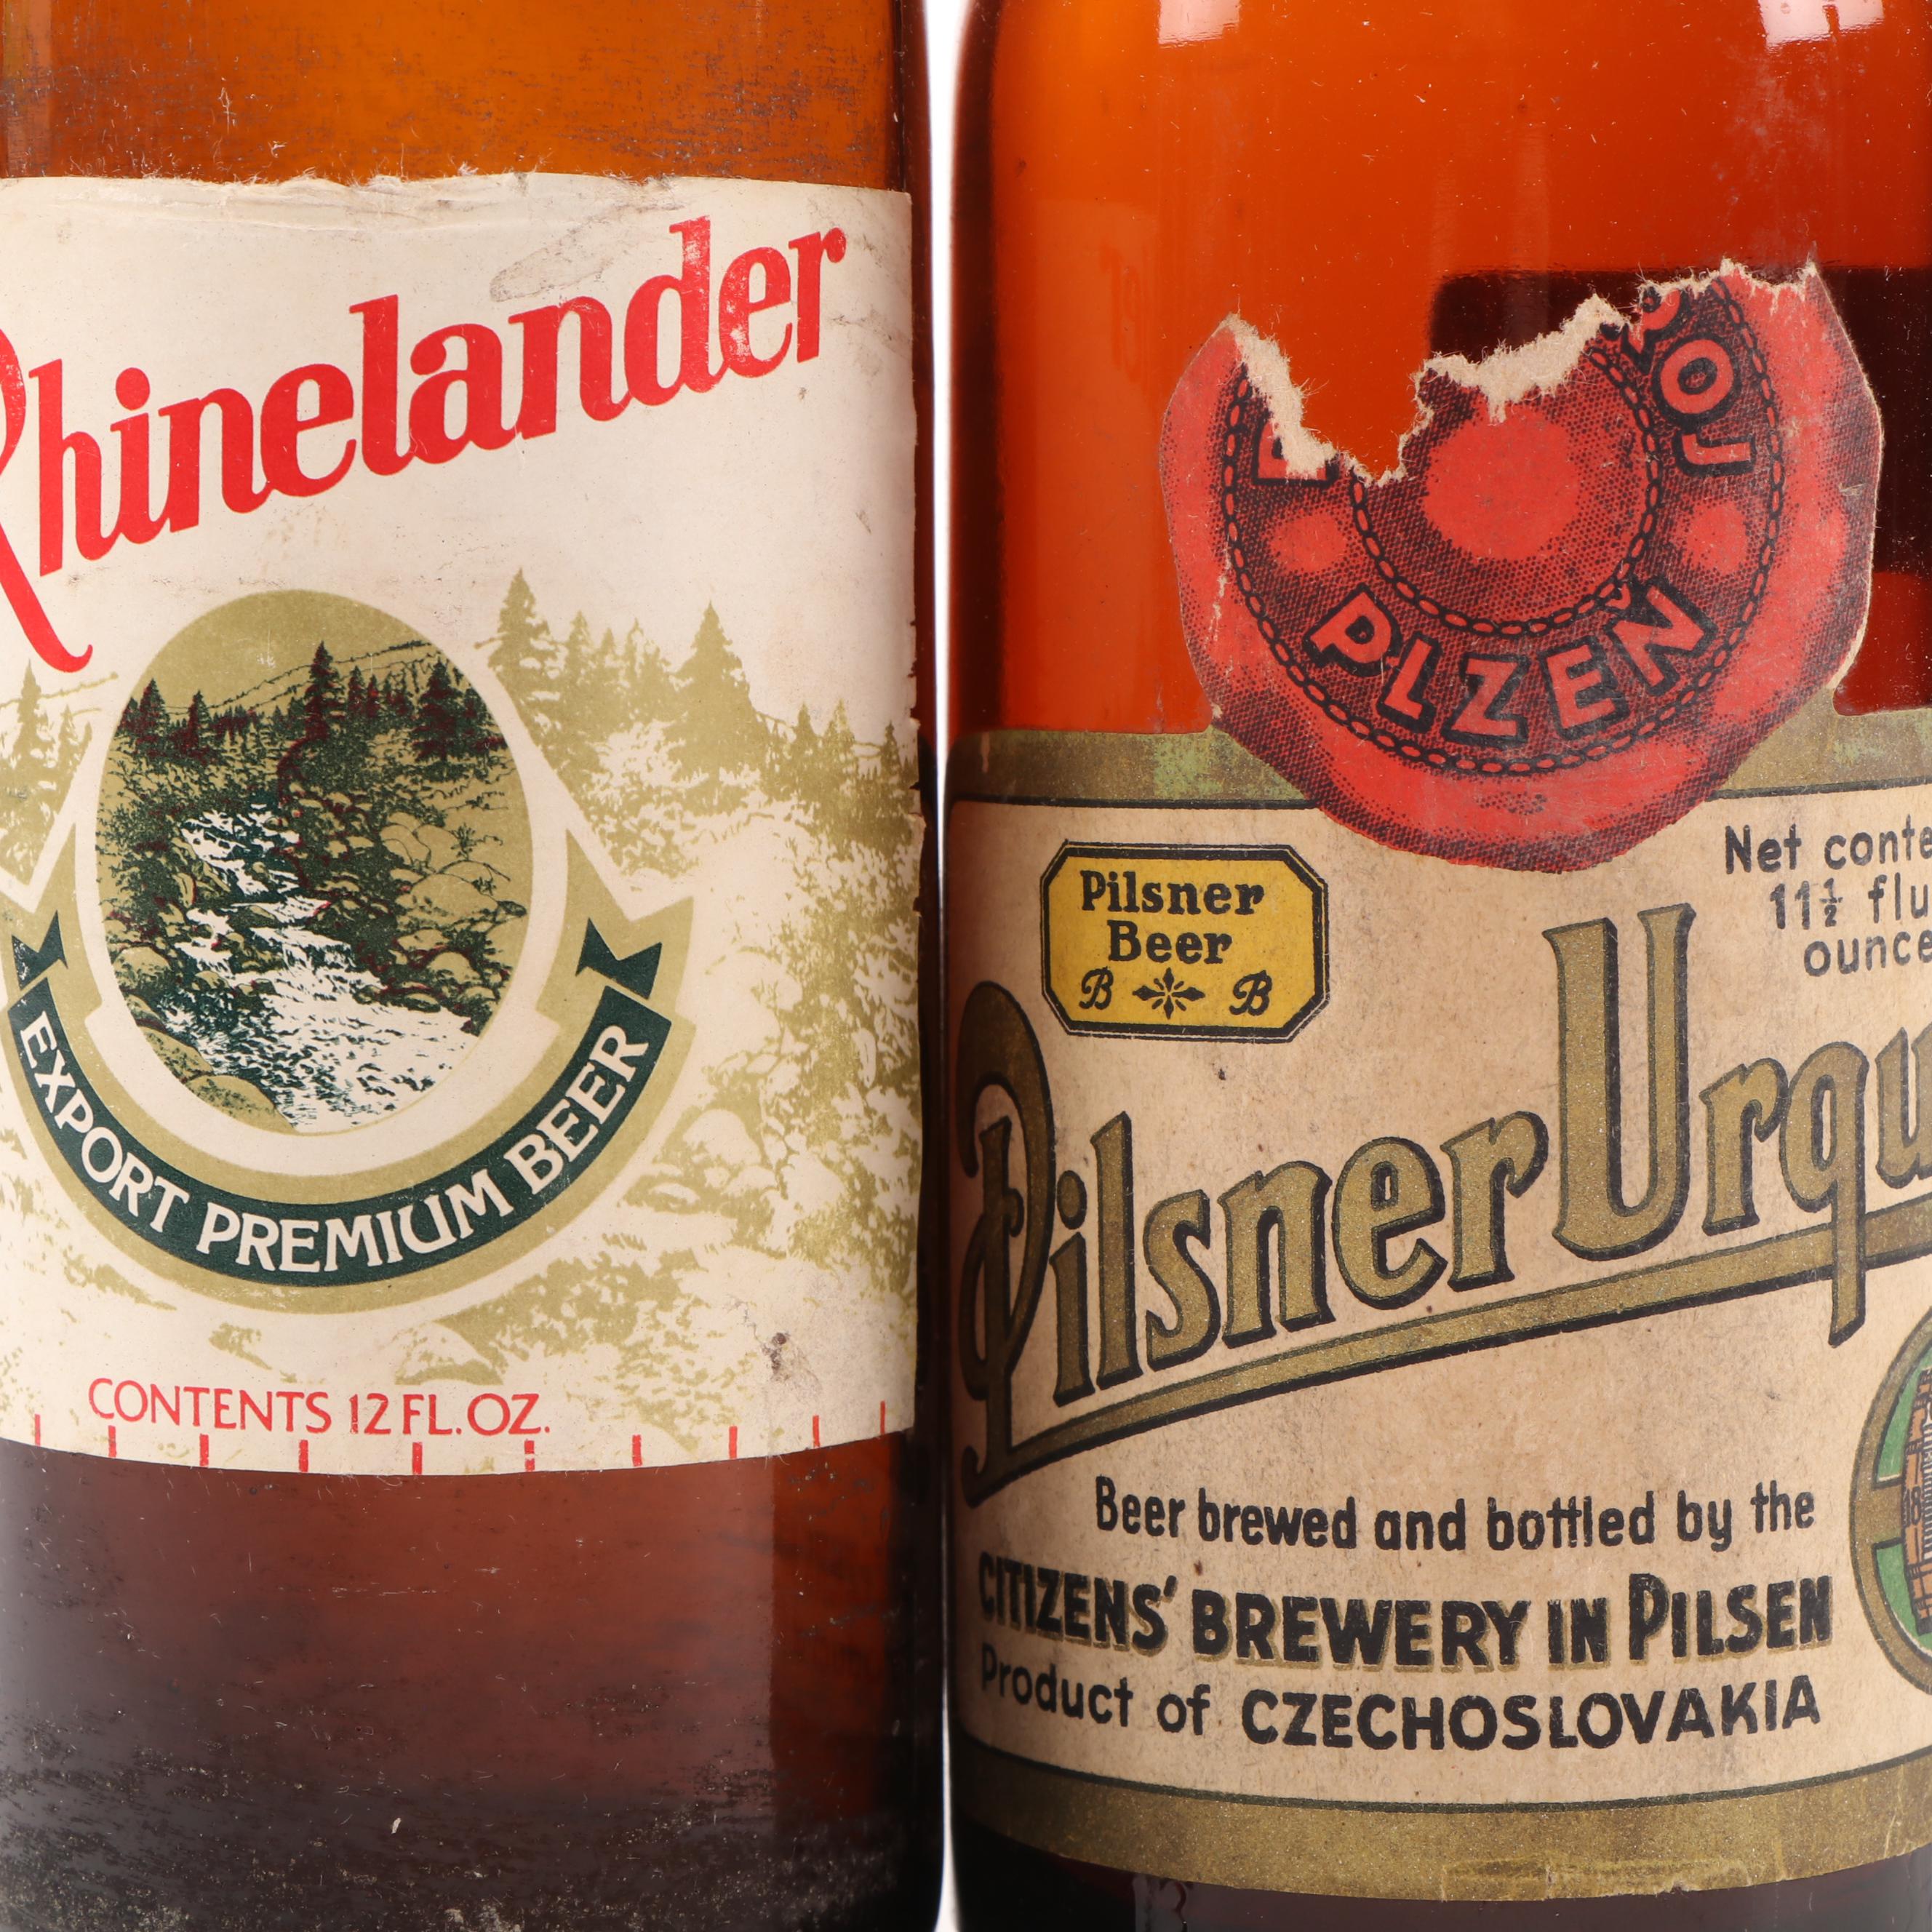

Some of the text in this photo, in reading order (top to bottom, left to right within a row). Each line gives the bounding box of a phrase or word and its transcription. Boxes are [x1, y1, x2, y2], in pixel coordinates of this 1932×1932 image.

[1725, 823, 1802, 874] Net
[1080, 870, 1265, 916] Pilsner
[1107, 919, 1232, 965] Beer
[1079, 966, 1273, 1017] B B
[18, 1014, 649, 1274] EXPORT PREMIUM BEER
[955, 981, 1549, 1509] Pilsner
[88, 1377, 332, 1434] CONTENTS
[1095, 1474, 1816, 1552] Beer brewed and bottled by the
[978, 1550, 1834, 1673] CITIZENS' BREWERY IN PILSEN
[982, 1642, 1821, 1751] Product of CZECHOSLOVAKIA
